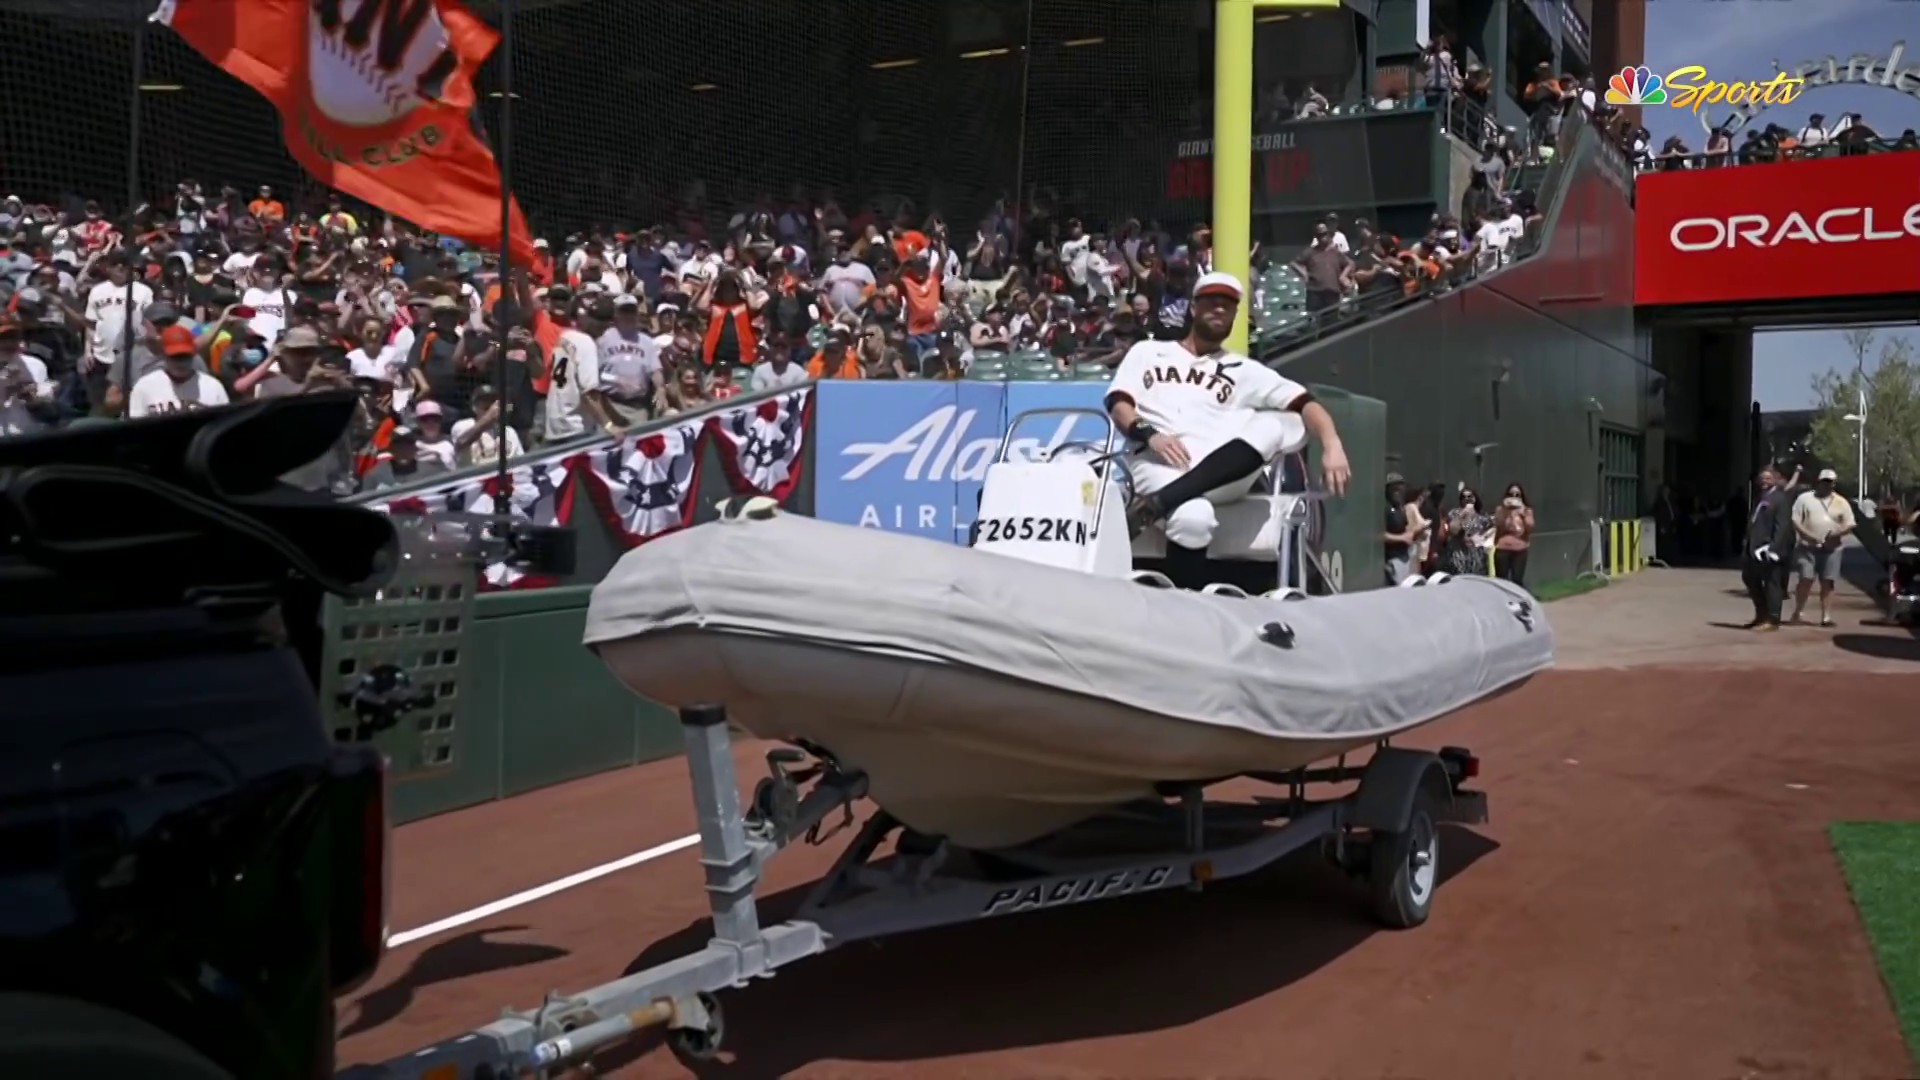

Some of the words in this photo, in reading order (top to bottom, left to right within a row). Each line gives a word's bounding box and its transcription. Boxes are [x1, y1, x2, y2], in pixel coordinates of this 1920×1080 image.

[362, 123, 442, 167] CLUB
[1177, 138, 1214, 158] GIAN
[1252, 131, 1297, 151] EBALL
[1143, 366, 1233, 404] GIANTS
[840, 404, 1123, 482] Alas
[859, 504, 970, 529] AIRL
